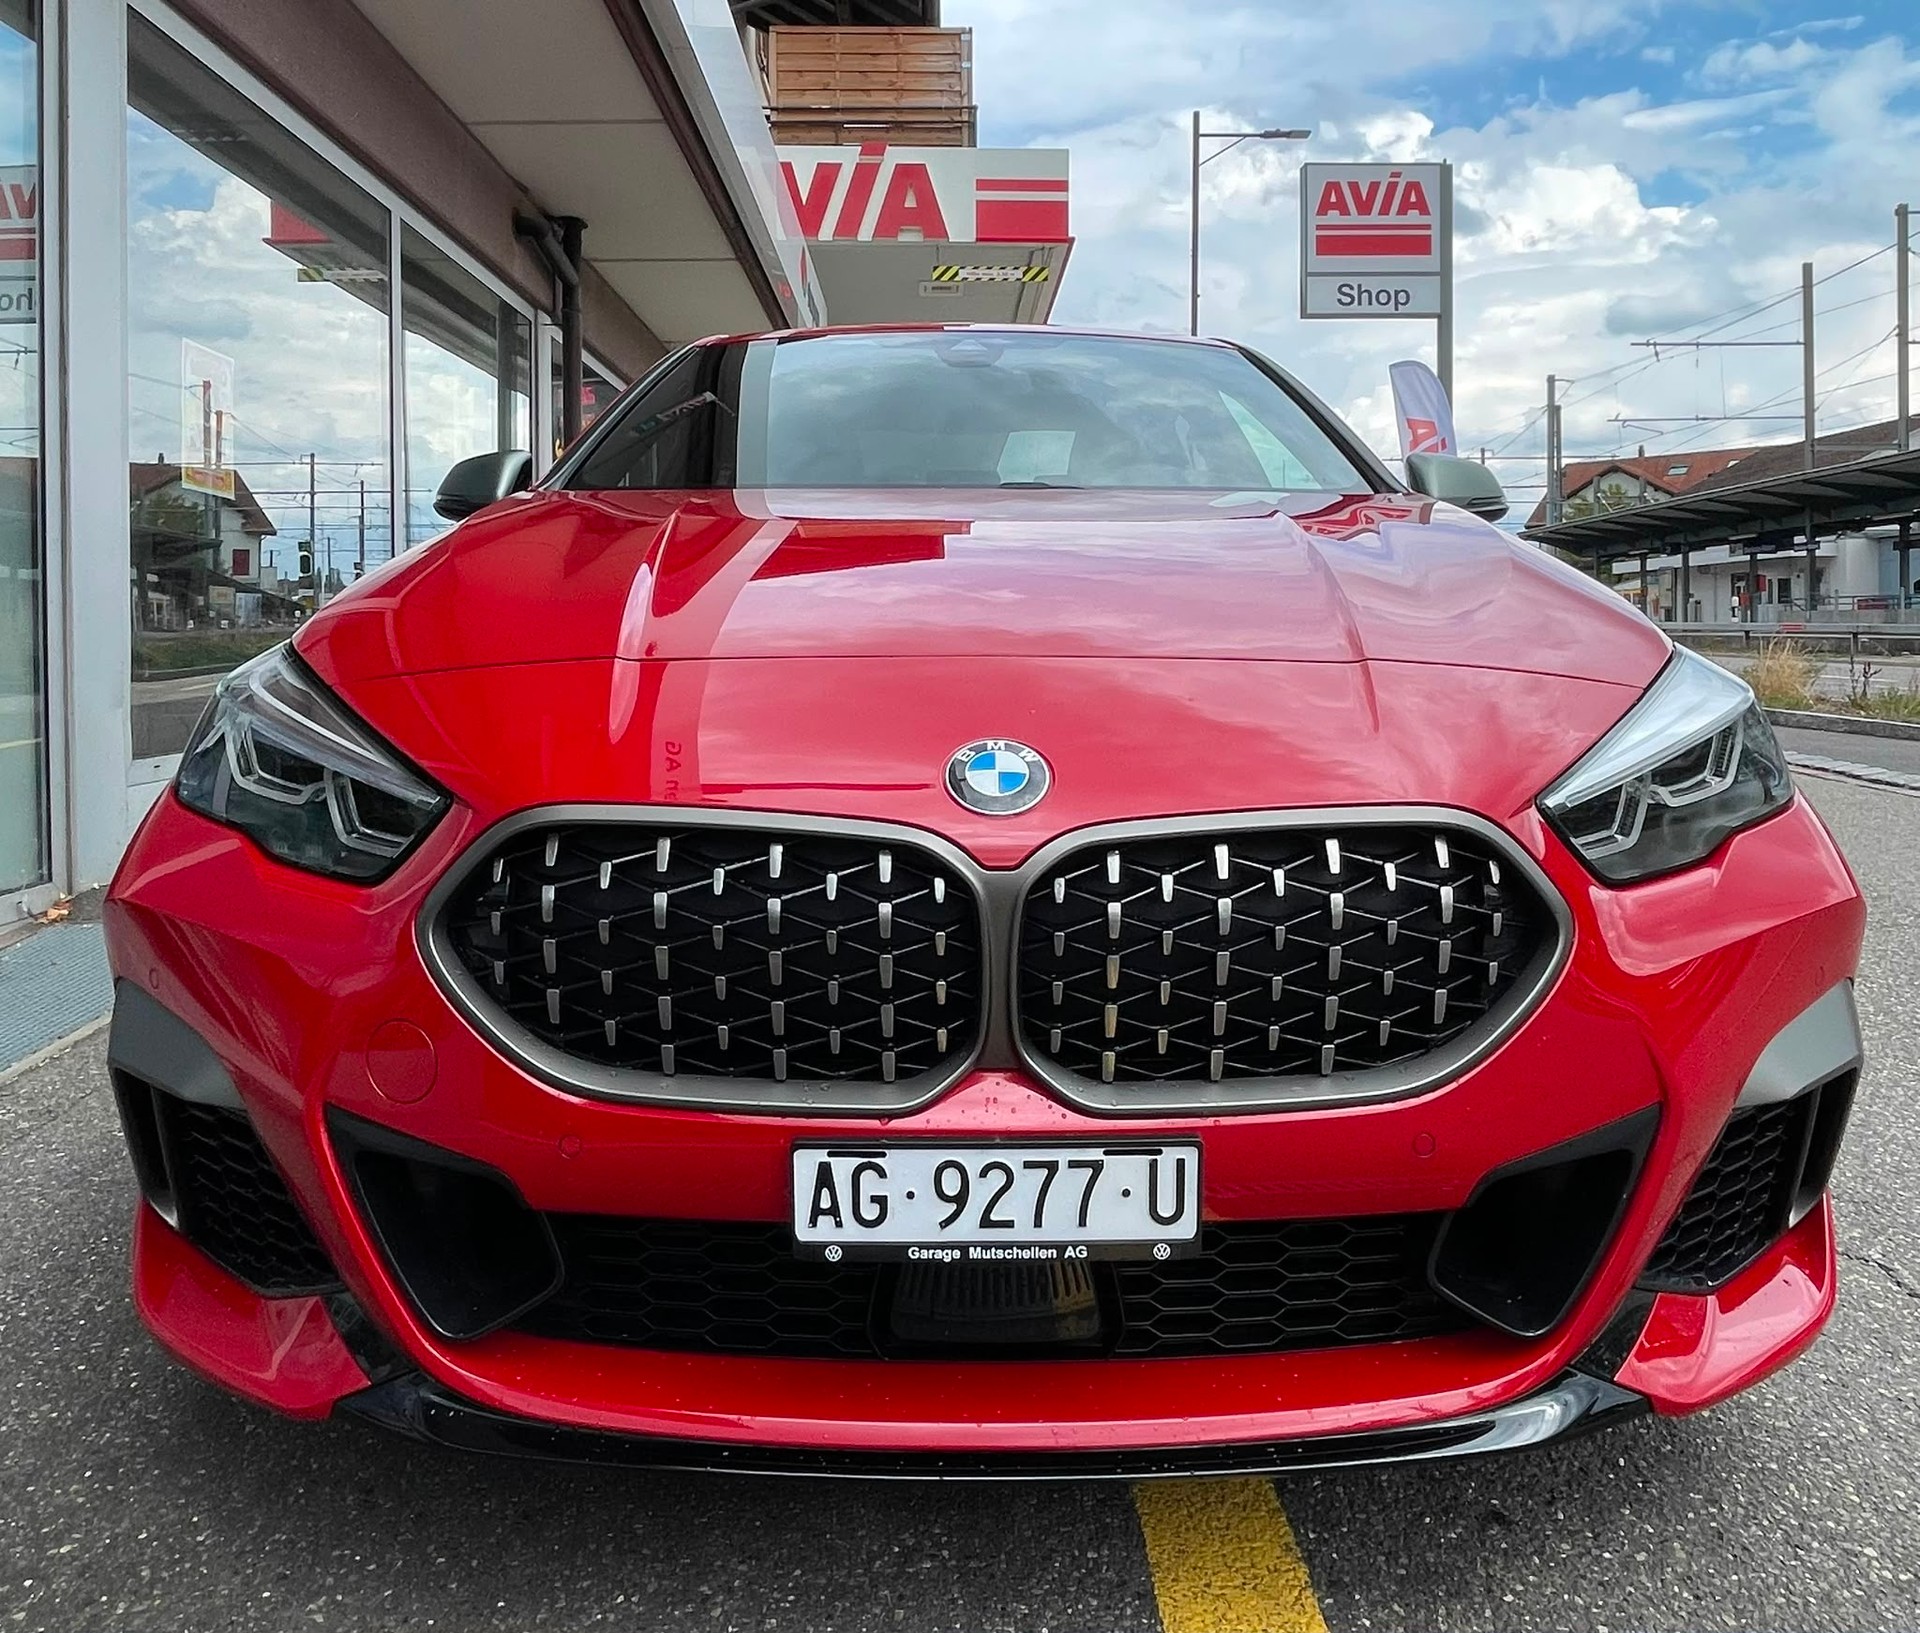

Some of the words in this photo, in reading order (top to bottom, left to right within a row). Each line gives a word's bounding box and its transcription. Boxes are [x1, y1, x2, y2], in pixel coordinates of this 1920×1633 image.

[1337, 283, 1411, 311] Shop
[955, 741, 1039, 763] BMW
[908, 1247, 961, 1262] Garage
[969, 1246, 1057, 1260] Mutschellen
[1064, 1245, 1088, 1259] AG
